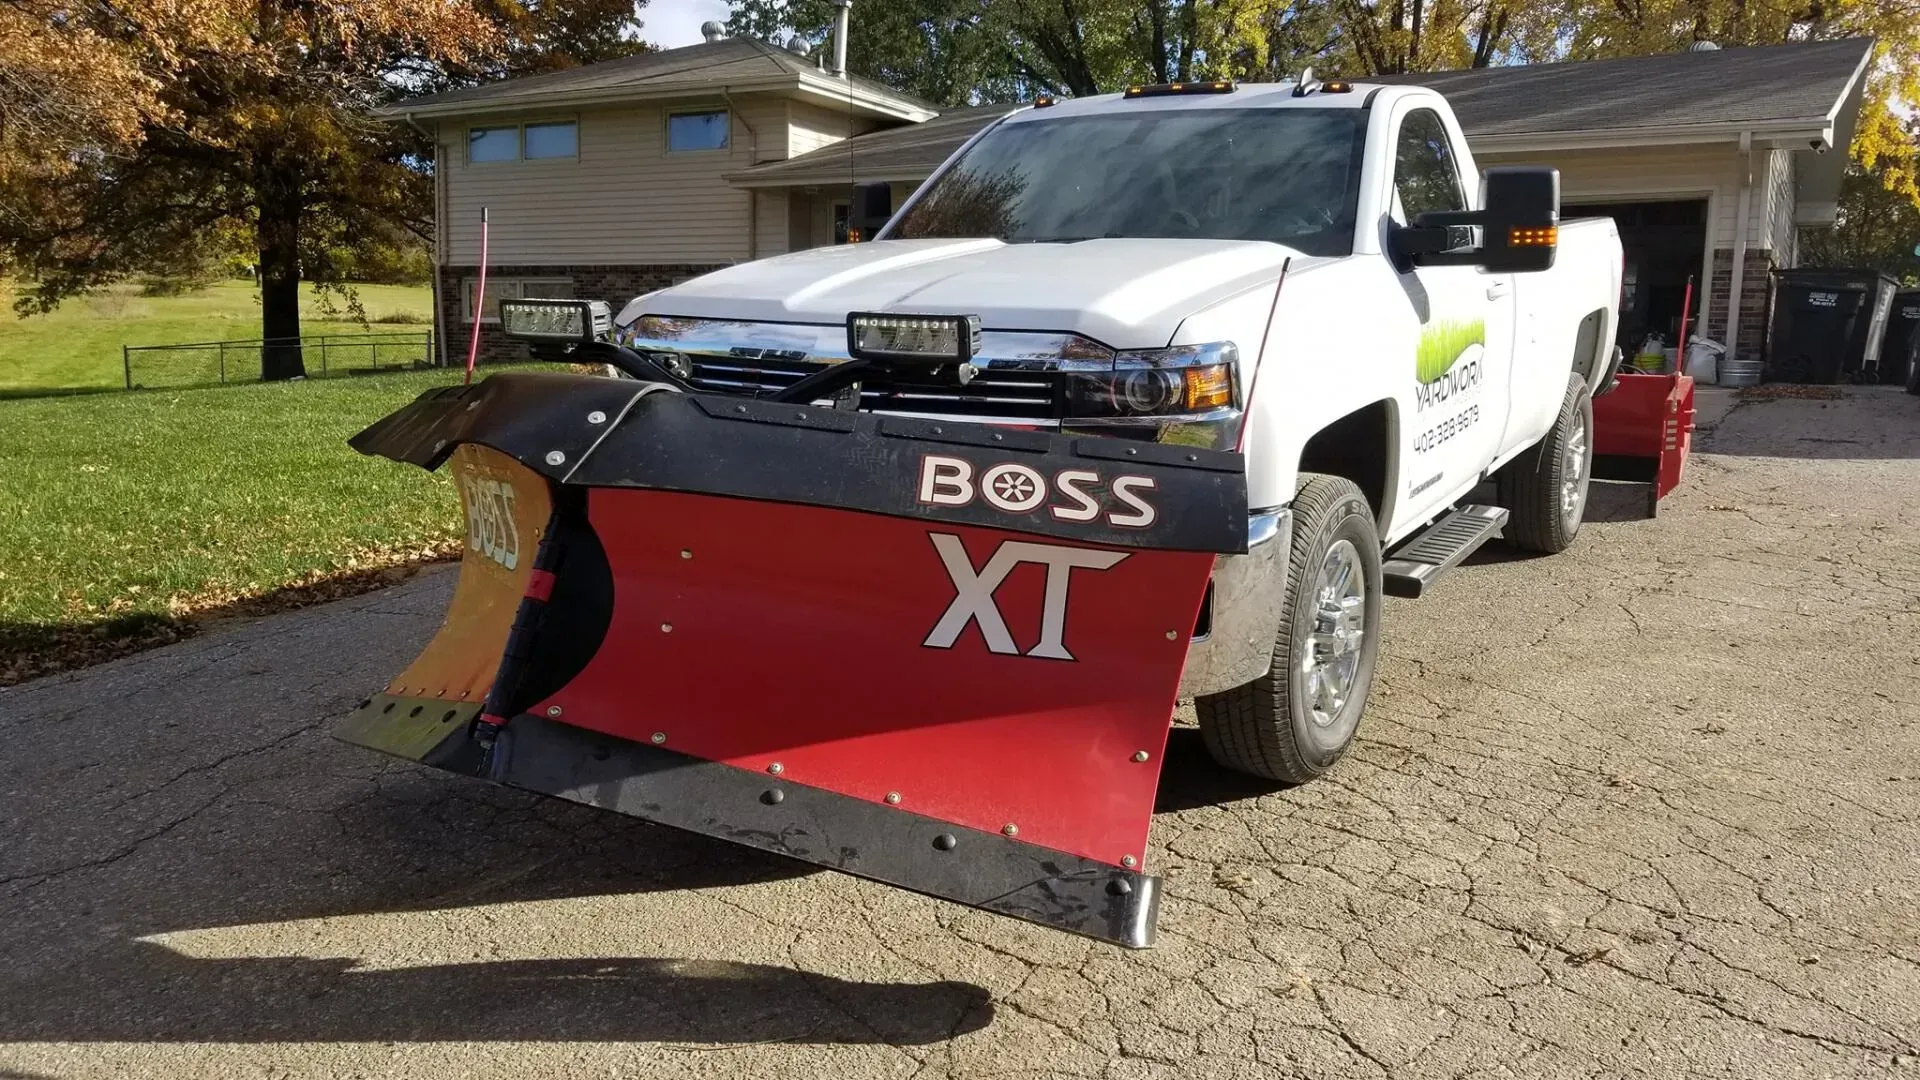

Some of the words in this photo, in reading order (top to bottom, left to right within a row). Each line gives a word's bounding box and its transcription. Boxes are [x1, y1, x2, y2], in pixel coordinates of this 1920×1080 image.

[463, 473, 518, 570] BOSS
[918, 455, 1158, 528] BOSS
[921, 531, 1133, 662] XT
